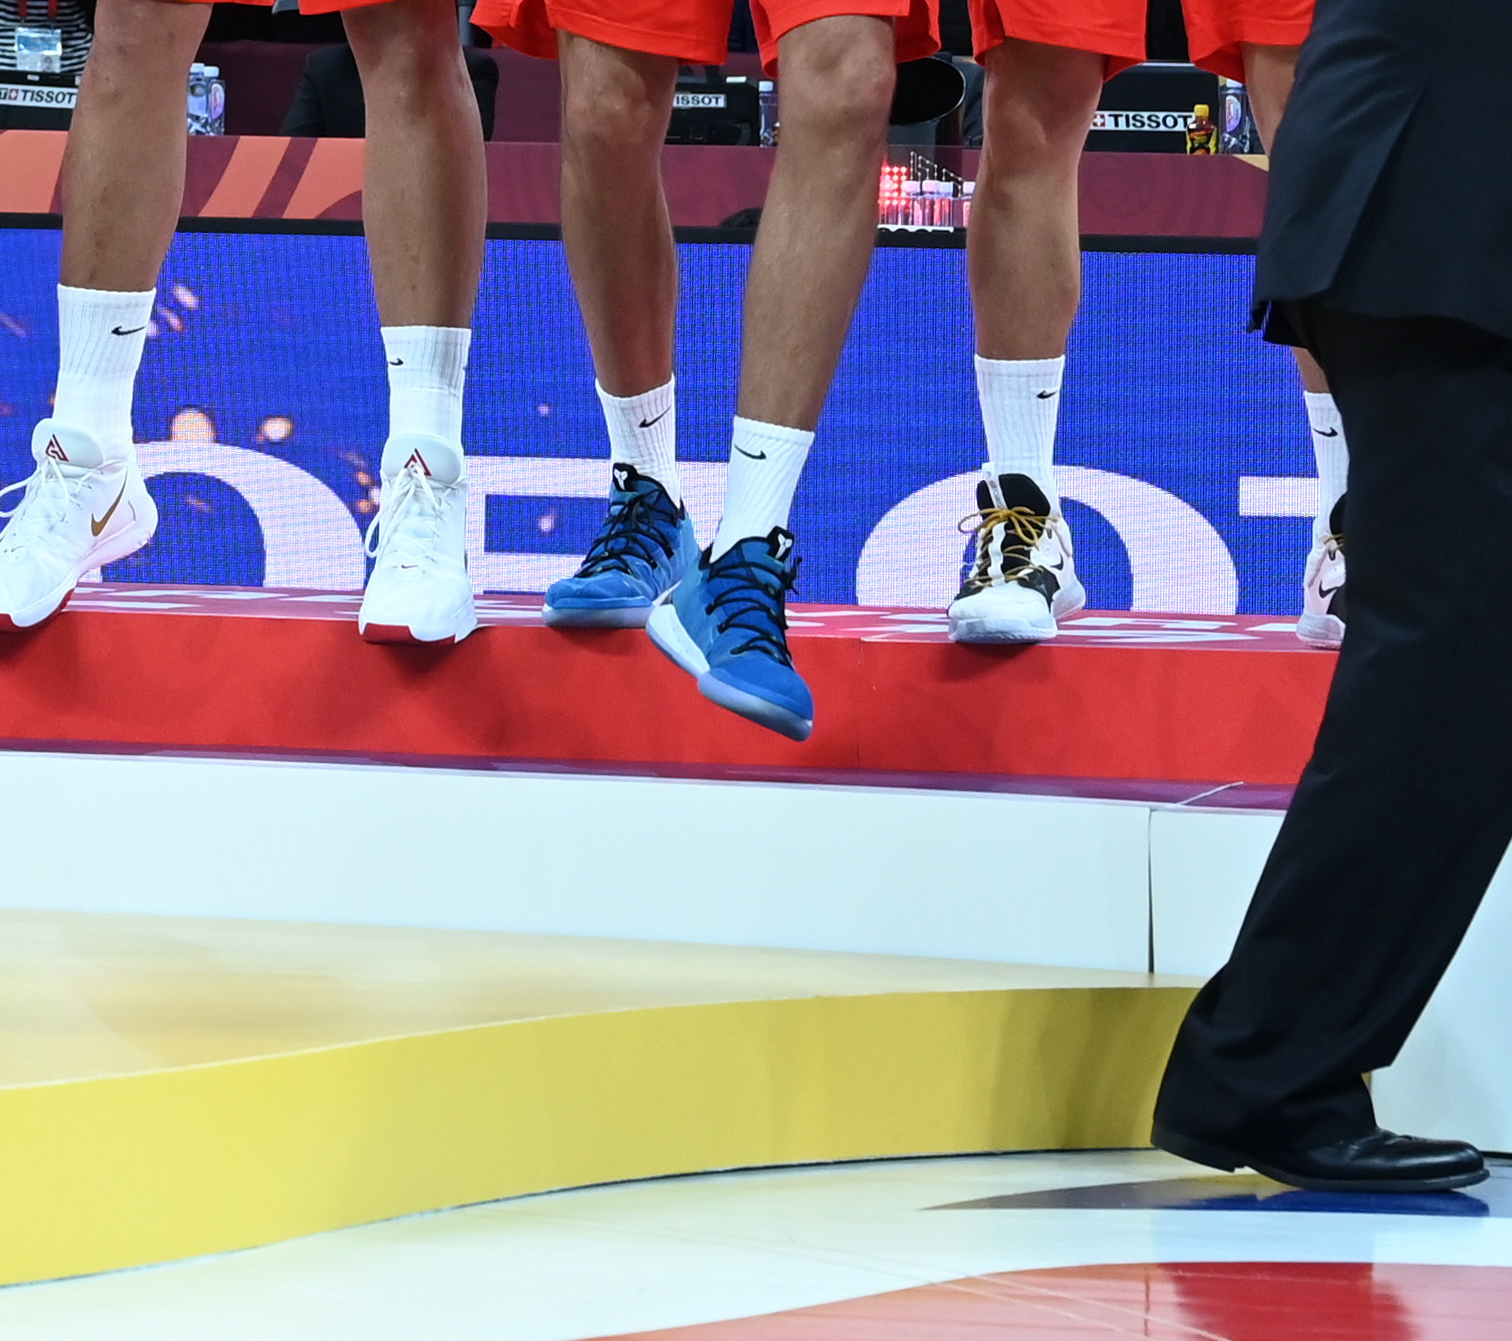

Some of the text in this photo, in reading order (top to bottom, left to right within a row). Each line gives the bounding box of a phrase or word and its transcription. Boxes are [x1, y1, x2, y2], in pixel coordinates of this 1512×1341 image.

[21, 89, 76, 105] TISSOT
[676, 95, 722, 106] ISSOT
[1108, 114, 1195, 129] TISSOT
